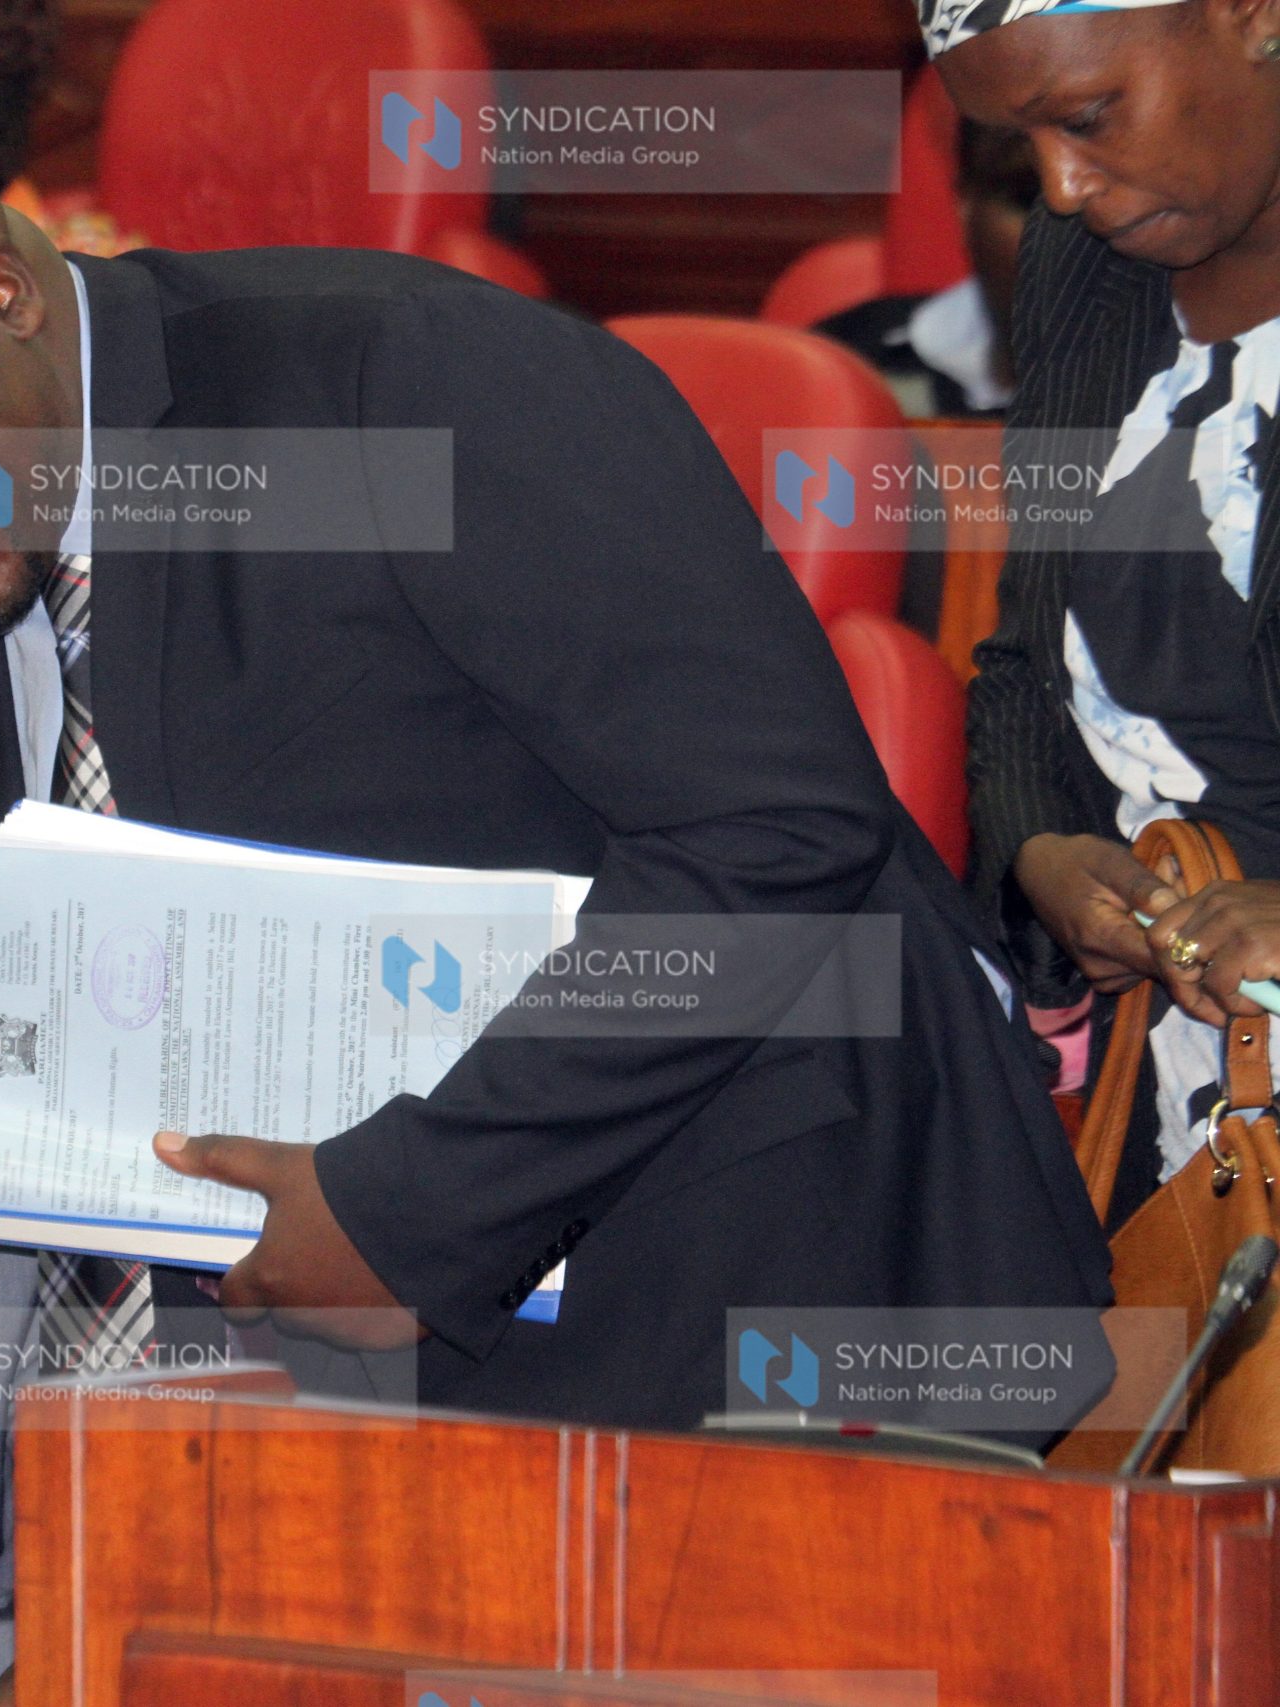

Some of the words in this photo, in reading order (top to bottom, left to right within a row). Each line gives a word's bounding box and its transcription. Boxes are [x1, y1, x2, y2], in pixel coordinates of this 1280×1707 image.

[175, 935, 183, 979] ASSEMBLY
[172, 988, 181, 1031] NATIONAL
[346, 1057, 354, 1088] October,
[351, 947, 360, 984] Chamber,
[37, 1012, 47, 1084] PARLIAMENT
[108, 1071, 116, 1096] Human
